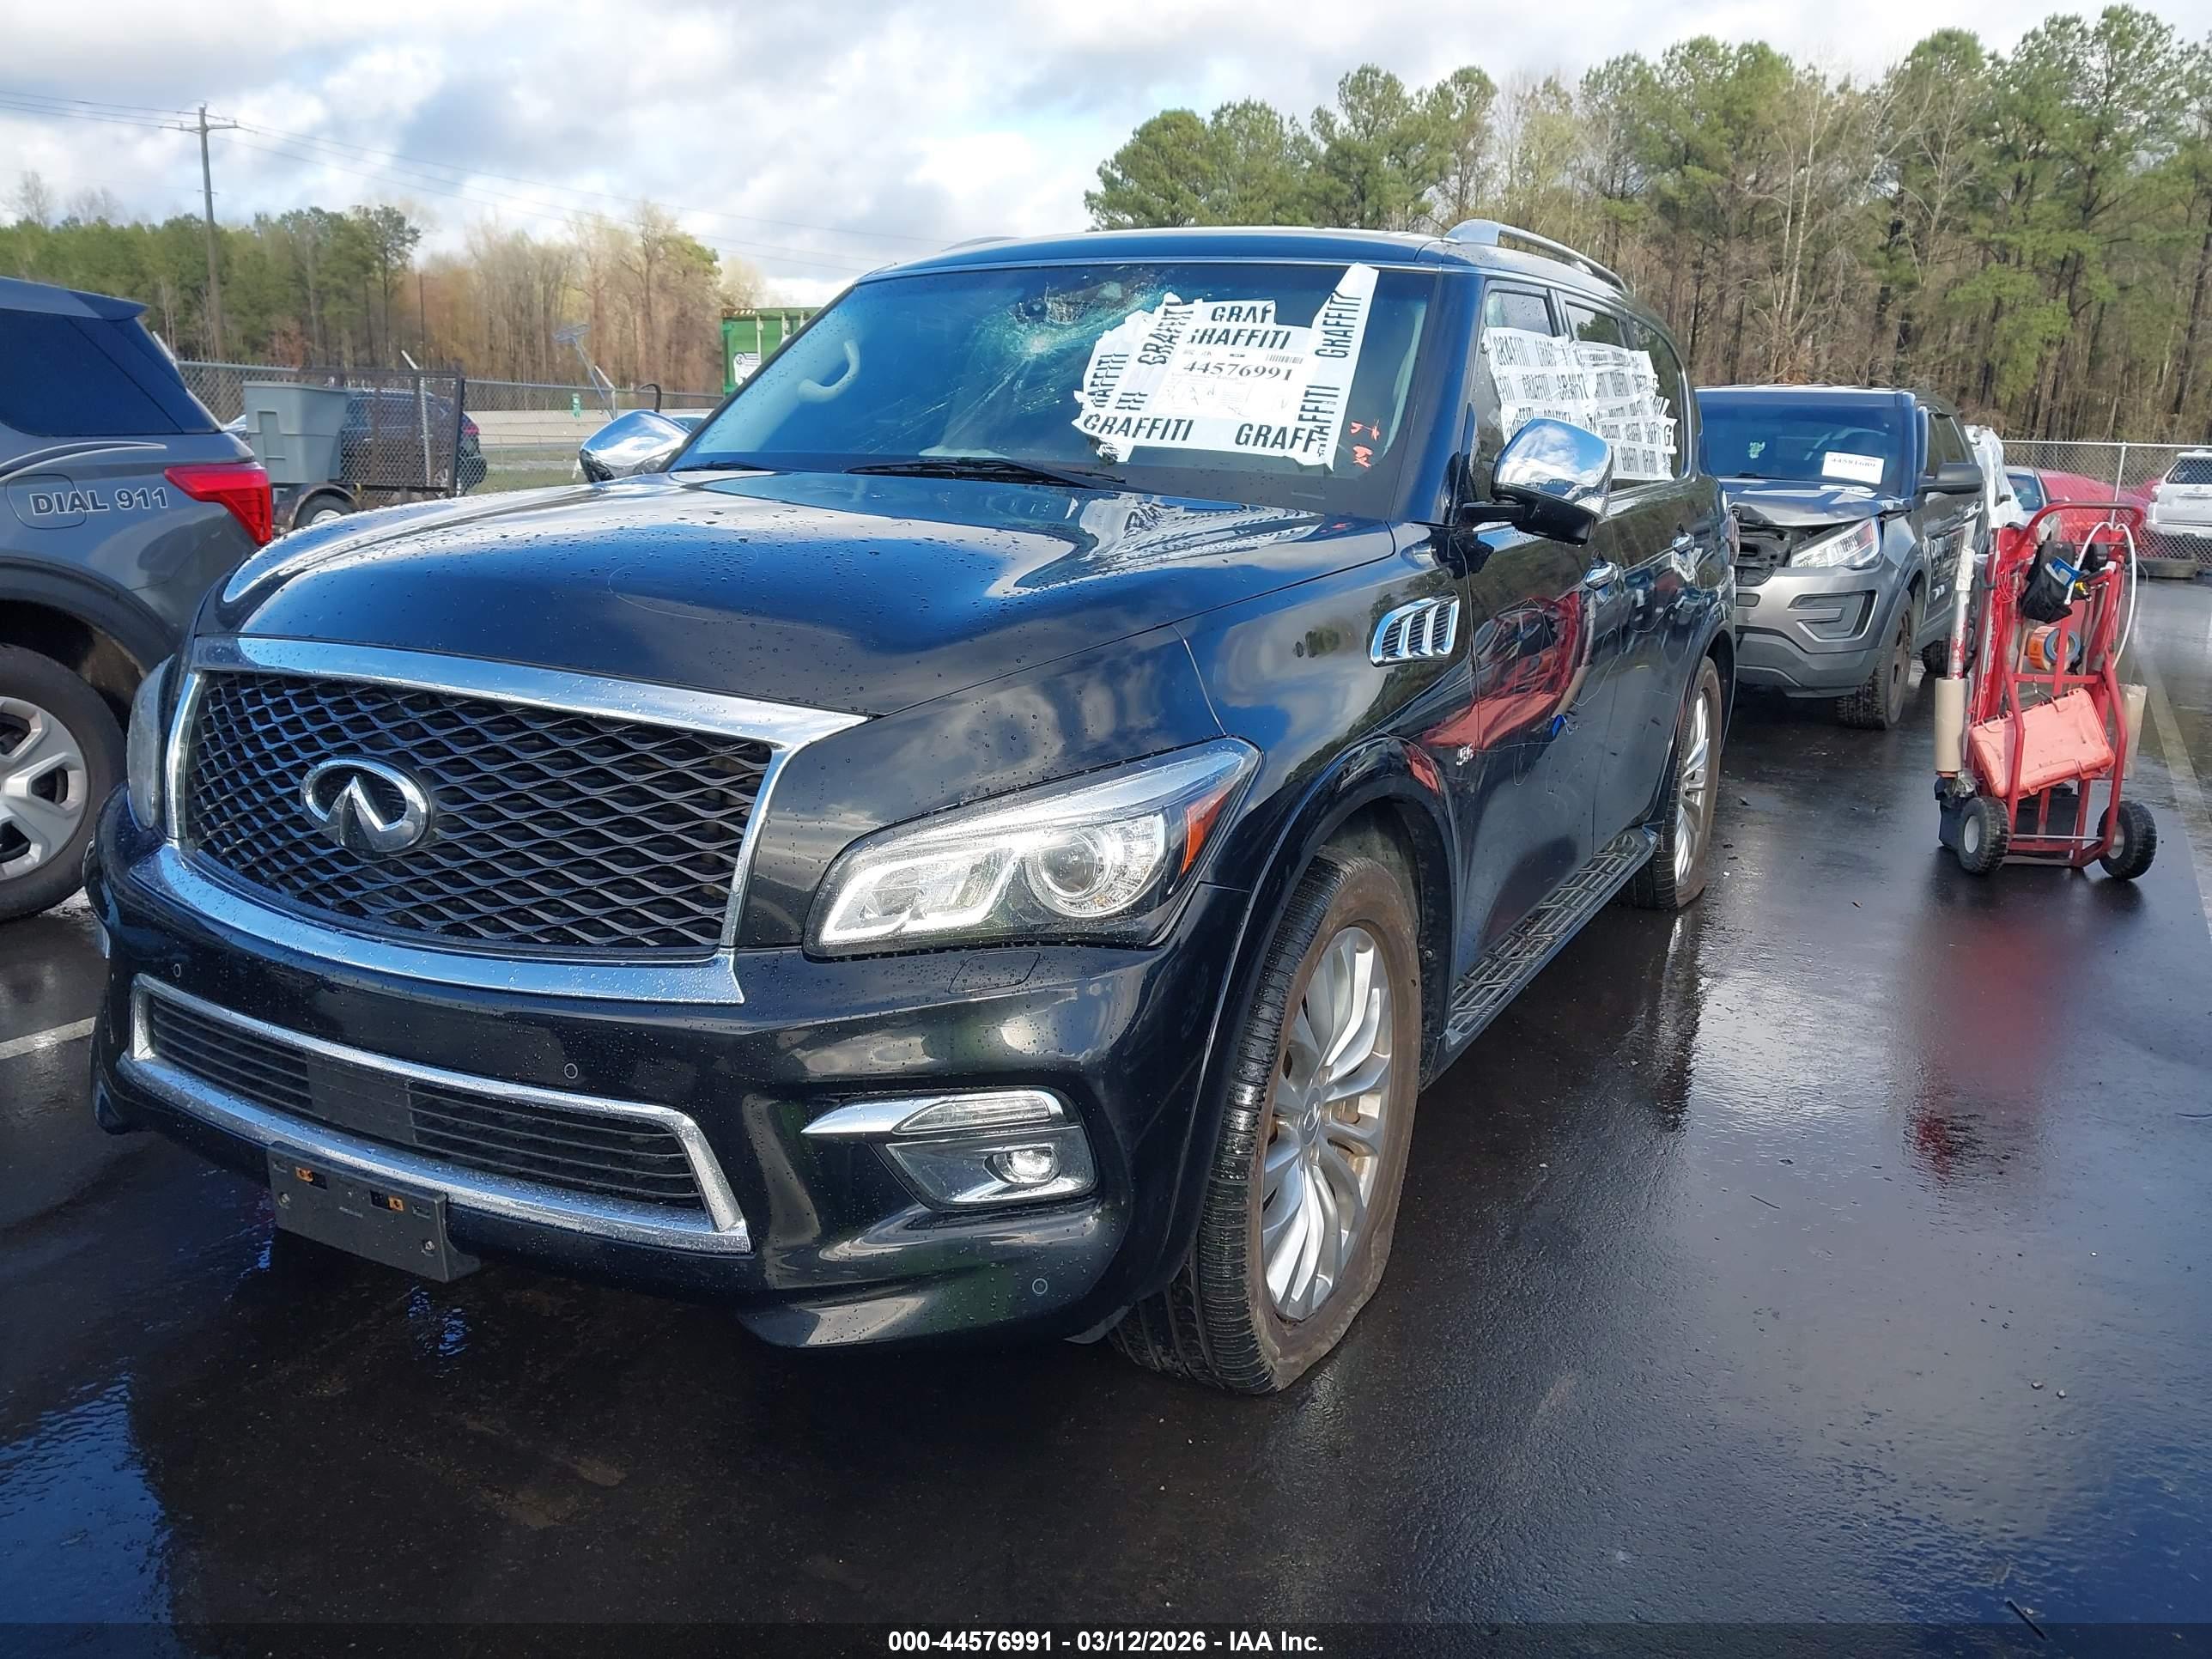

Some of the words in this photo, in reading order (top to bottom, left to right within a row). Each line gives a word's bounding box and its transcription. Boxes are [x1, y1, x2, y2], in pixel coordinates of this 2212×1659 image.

[1314, 290, 1362, 358] GRAFFITI
[1183, 361, 1292, 380] 44576991
[1083, 413, 1194, 441] GRAFFITI
[1235, 423, 1319, 453] GRAFF
[29, 489, 110, 515] DIAL
[114, 487, 168, 509] 911
